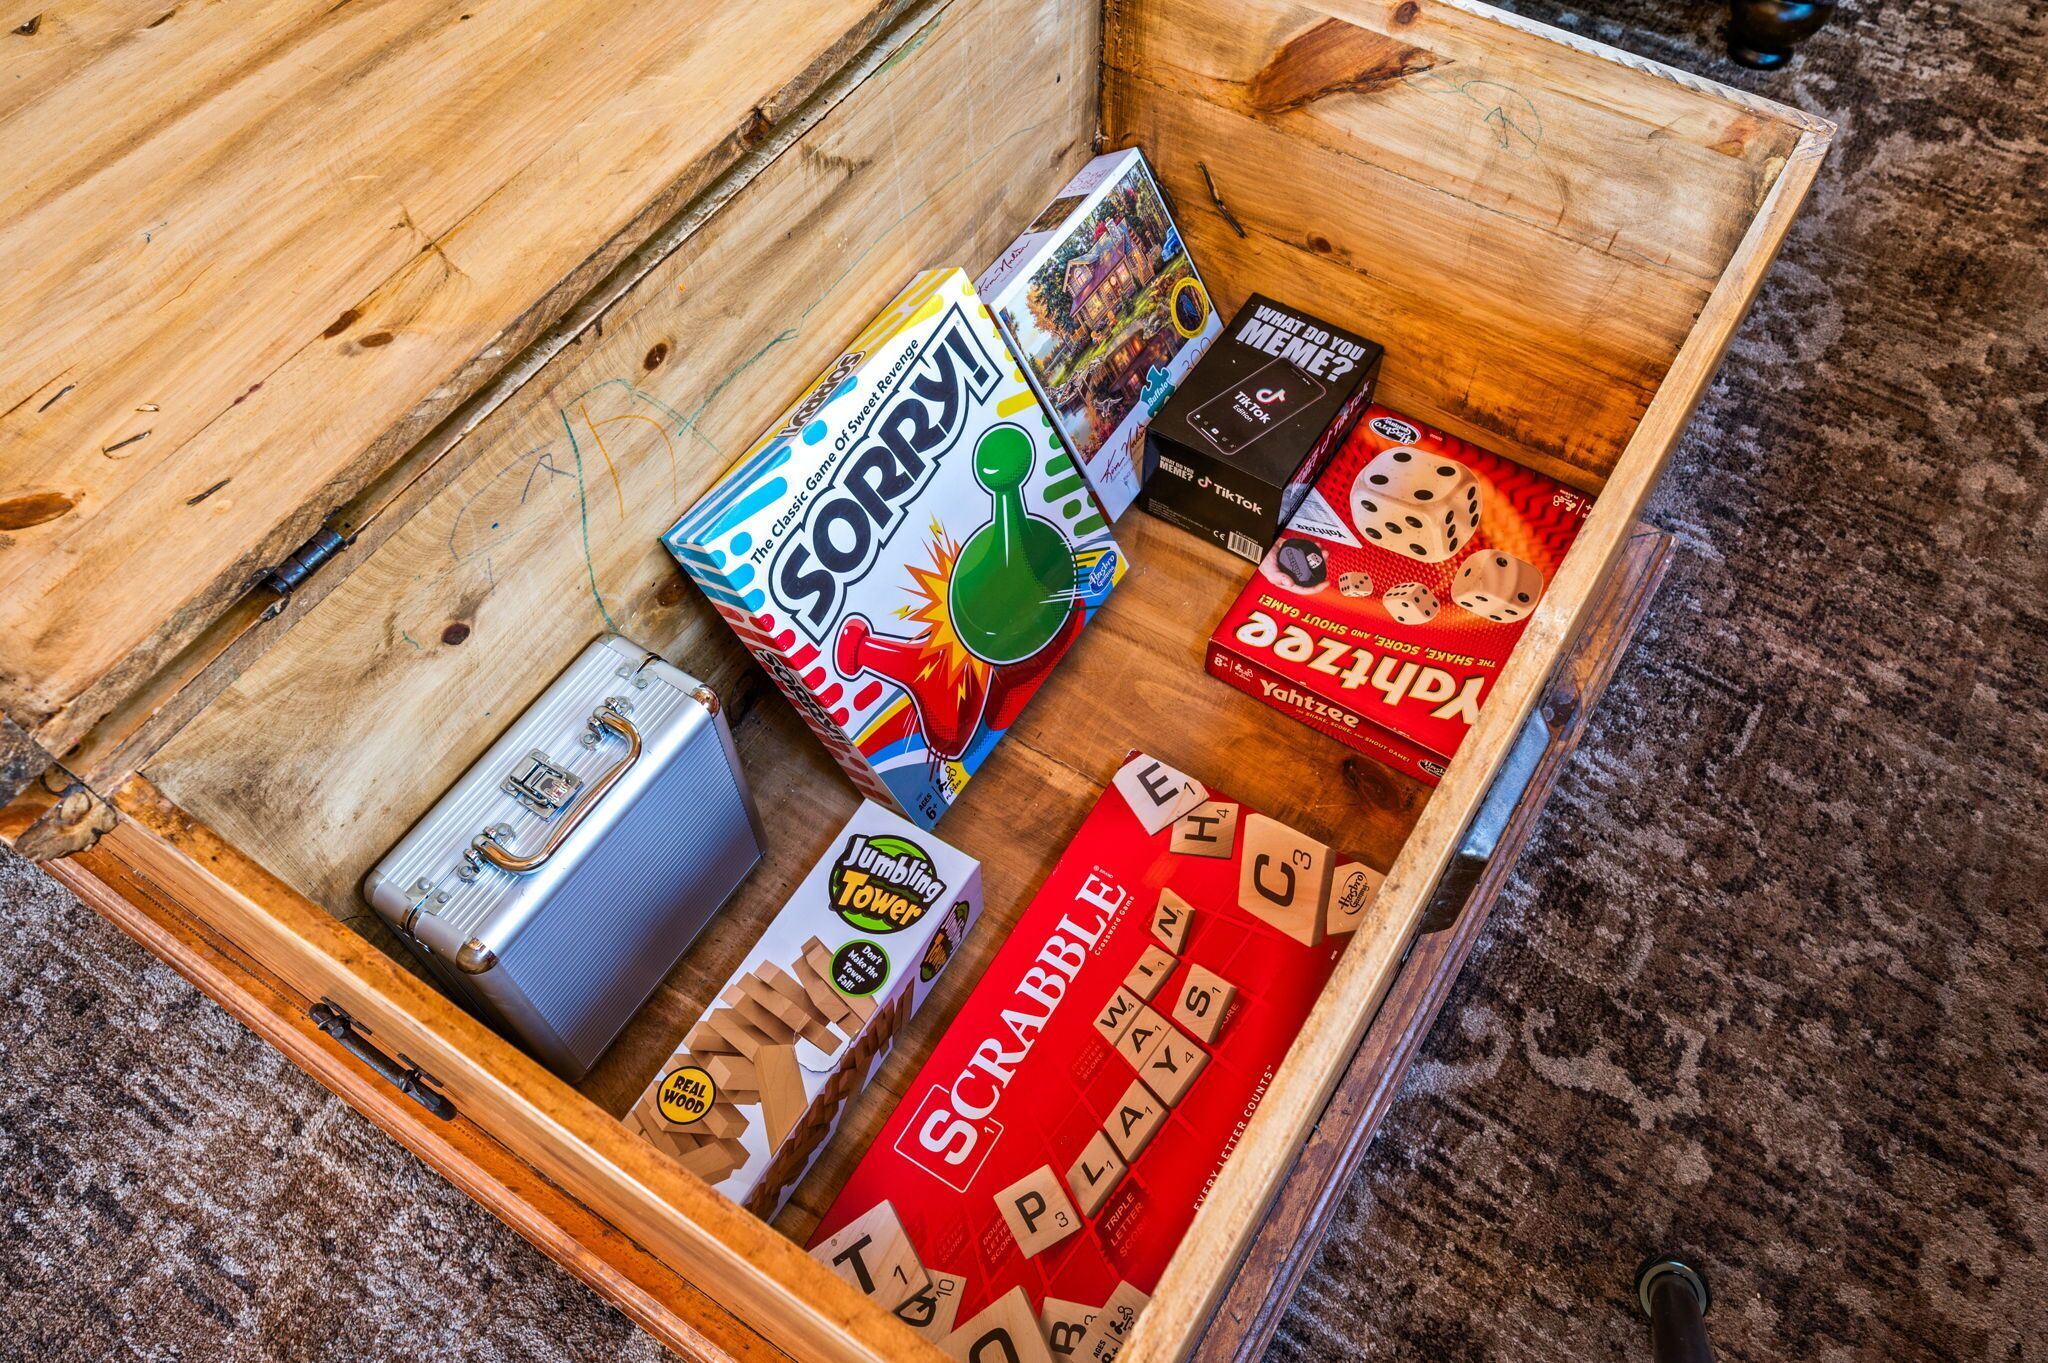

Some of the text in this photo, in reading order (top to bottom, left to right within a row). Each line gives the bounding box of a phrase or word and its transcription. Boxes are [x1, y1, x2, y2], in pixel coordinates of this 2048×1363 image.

[1235, 317, 1354, 382] MEME?
[1254, 305, 1366, 360] WHAT DO YOU
[1148, 381, 1169, 407] Buffalo
[1235, 391, 1271, 424] TikTok
[1233, 404, 1253, 422] Edition
[1375, 421, 1415, 444] Hasbro
[750, 339, 919, 566] The Classic Game Of Sweet Revenge
[1160, 456, 1175, 467] WHAT
[1182, 464, 1194, 474] YOU
[778, 322, 991, 628] SORRY!
[1160, 461, 1194, 482] MEME?
[1214, 483, 1262, 515] TikTok
[1090, 555, 1115, 585] Hasbro
[1258, 594, 1496, 668] THE SHAKE, SCORE, AND SHOUT GAME!
[1236, 610, 1487, 725] Yahtzee
[757, 651, 850, 744] SORRY!
[1260, 679, 1360, 729] Yahtzee
[1306, 712, 1329, 725] SHAKE,
[1364, 736, 1388, 751] SHOUT
[1388, 749, 1411, 763] GAME!
[919, 793, 932, 811] AGES
[1136, 762, 1179, 807] E
[926, 804, 938, 820] 6+
[1184, 815, 1219, 843] H
[843, 837, 944, 903] Jumbling
[1254, 853, 1296, 907] C
[838, 869, 923, 926] Tower
[1338, 874, 1364, 910] Hasbro
[1094, 896, 1135, 956] Crossword Game
[843, 962, 865, 983] Tower
[848, 950, 879, 979] Make the
[862, 945, 883, 965] Don't
[837, 974, 855, 991] Fall!
[918, 872, 1128, 1166] SCRABBLE
[663, 1088, 705, 1114] WOOD
[673, 1075, 706, 1098] REAL
[1193, 1071, 1273, 1211] EVERY LETTER COUNTS
[1104, 1192, 1135, 1232] TRIPLE
[1110, 1201, 1144, 1246] LETTER
[986, 1224, 1011, 1255] LETTE
[832, 1233, 876, 1295] T
[1093, 1340, 1106, 1359] AGES
